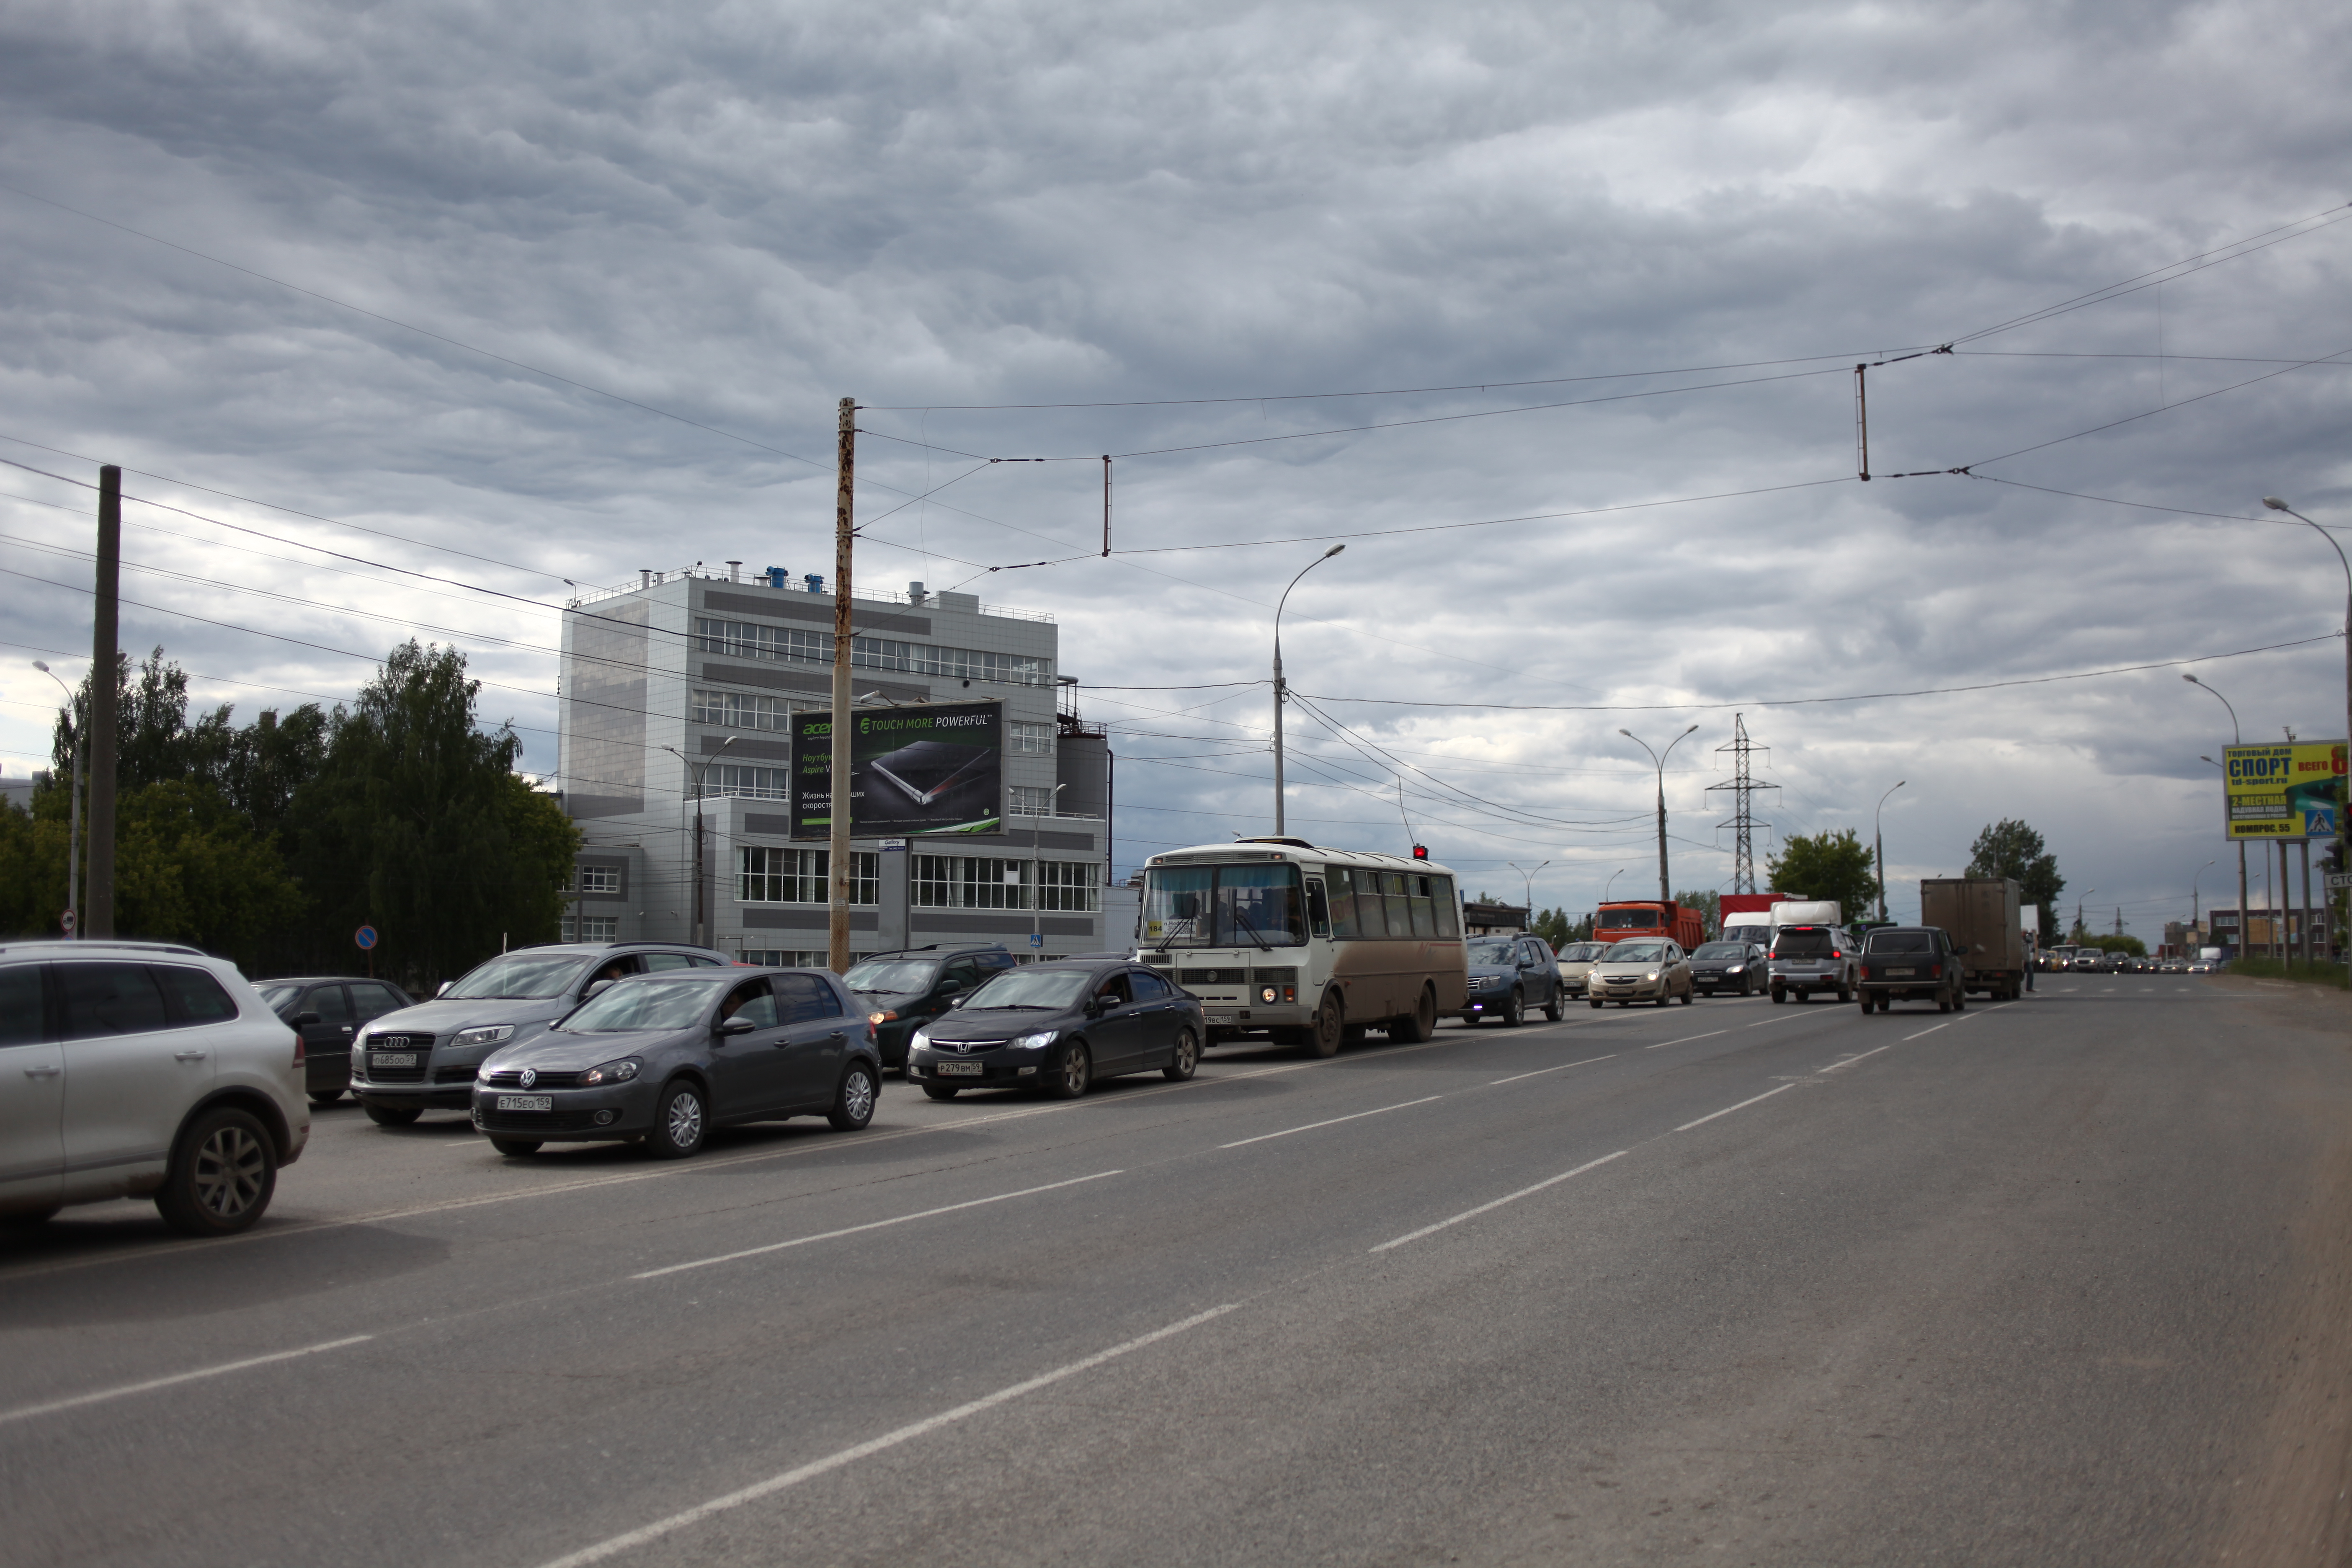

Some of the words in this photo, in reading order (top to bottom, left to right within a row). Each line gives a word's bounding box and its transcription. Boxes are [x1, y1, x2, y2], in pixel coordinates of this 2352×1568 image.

[803, 723, 832, 735] acer
[872, 720, 903, 730] TOUCH
[906, 718, 934, 729] MORE
[802, 766, 824, 775] Aspire
[2229, 757, 2292, 777] СПОРТ
[2298, 761, 2328, 771] ВСЕГО
[2232, 795, 2287, 806] 2-МЕСТНАЯ
[2235, 824, 2277, 833] КОМПРОС,
[2279, 824, 2290, 832] 55
[536, 1097, 549, 1106] 159
